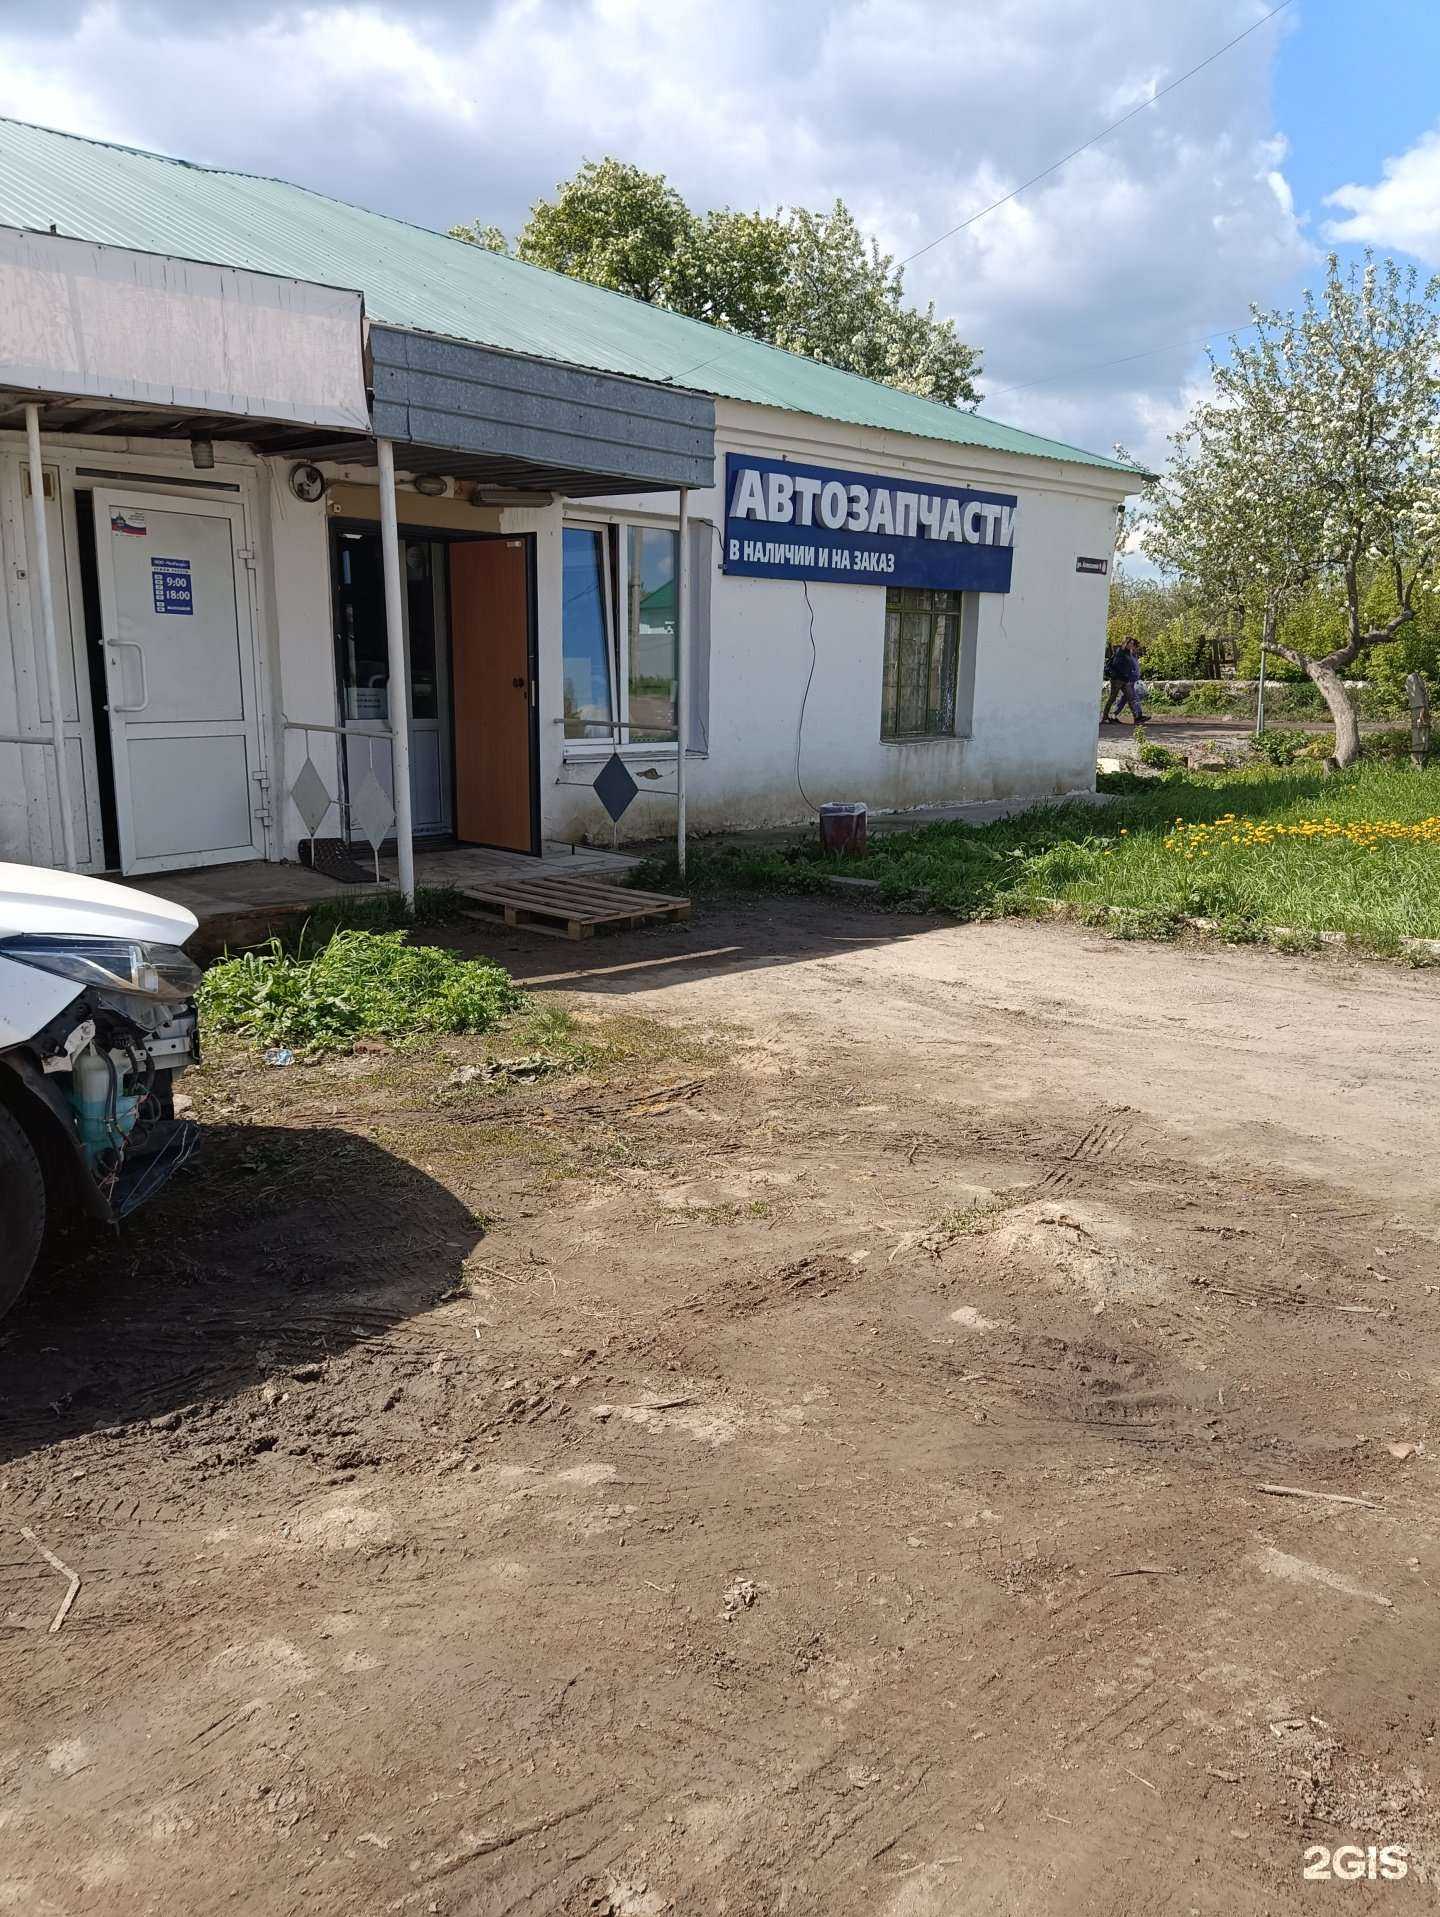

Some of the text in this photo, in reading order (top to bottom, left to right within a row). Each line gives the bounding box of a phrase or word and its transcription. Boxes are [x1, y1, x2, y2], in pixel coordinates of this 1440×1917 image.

[730, 468, 1019, 547] АВТОЗАПЧАСТИ
[729, 539, 895, 573] В НАЛИЧИИ И НА ЗАКАЗ
[166, 577, 187, 588] 9:00
[166, 590, 190, 600] 18:00
